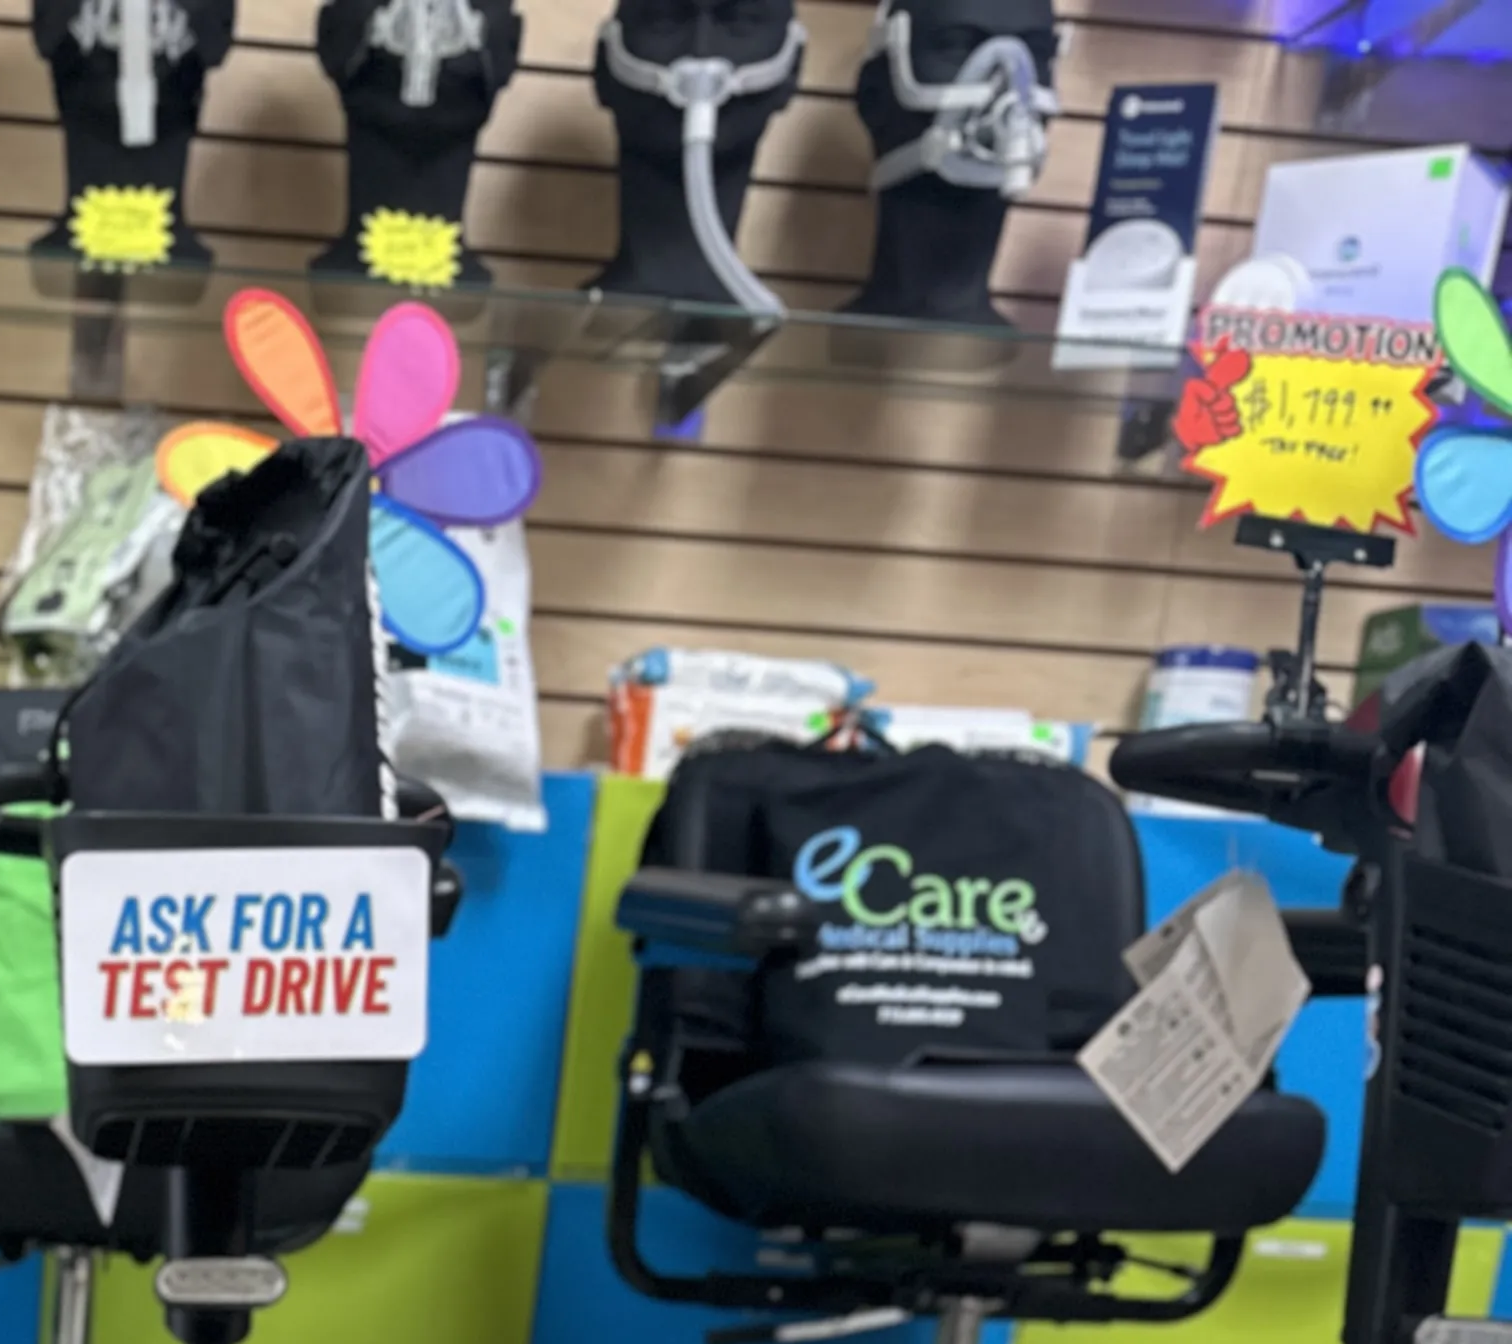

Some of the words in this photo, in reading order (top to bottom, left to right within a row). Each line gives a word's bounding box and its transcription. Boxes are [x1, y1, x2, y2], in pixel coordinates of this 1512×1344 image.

[1207, 312, 1437, 360] PROMOTION
[793, 825, 1036, 934] eCare
[109, 894, 218, 954] ASK
[229, 892, 330, 953] FOR
[341, 892, 375, 951] A
[98, 957, 230, 1020] TEST
[241, 956, 396, 1017] DRIVE
